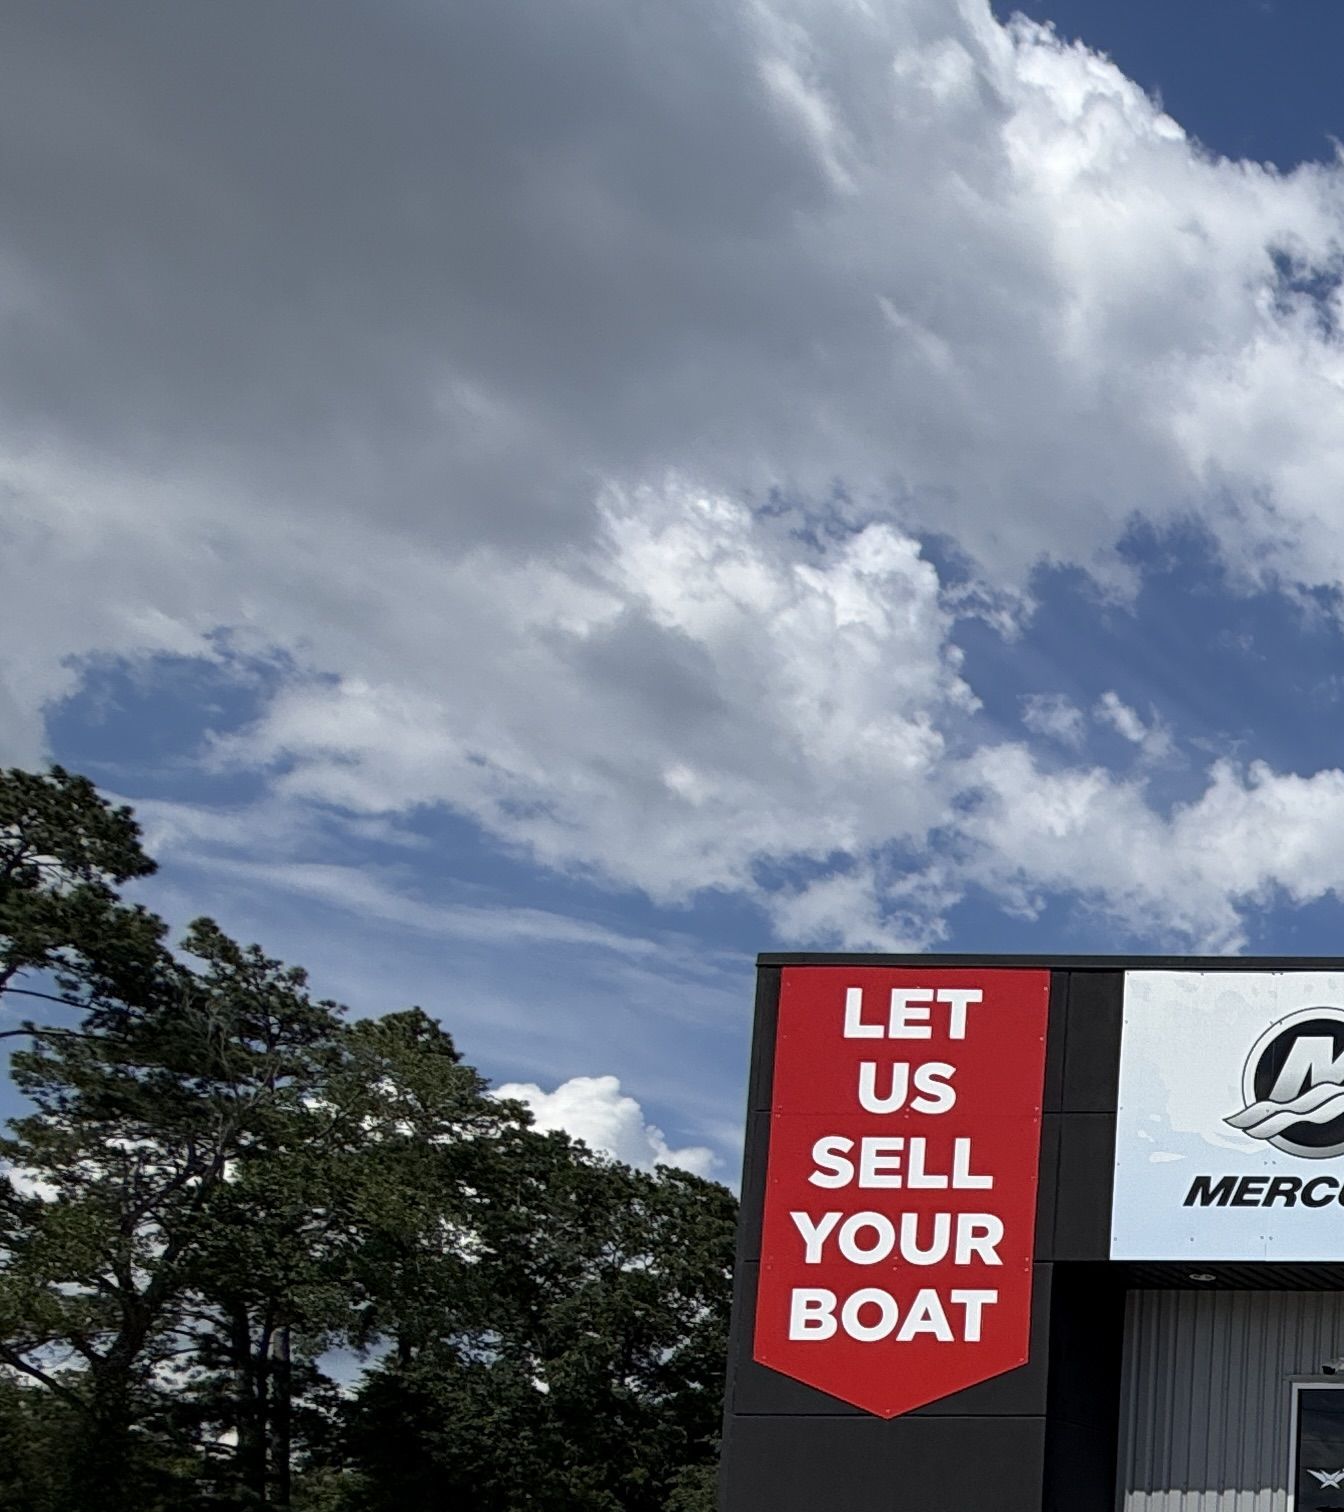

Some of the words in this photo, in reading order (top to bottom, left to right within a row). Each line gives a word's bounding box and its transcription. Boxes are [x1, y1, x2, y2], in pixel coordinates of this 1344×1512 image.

[843, 987, 983, 1040] LET
[858, 1061, 957, 1115] US
[808, 1135, 993, 1189] SELL
[790, 1211, 1004, 1266] YOUR
[788, 1287, 998, 1342] BOAT
